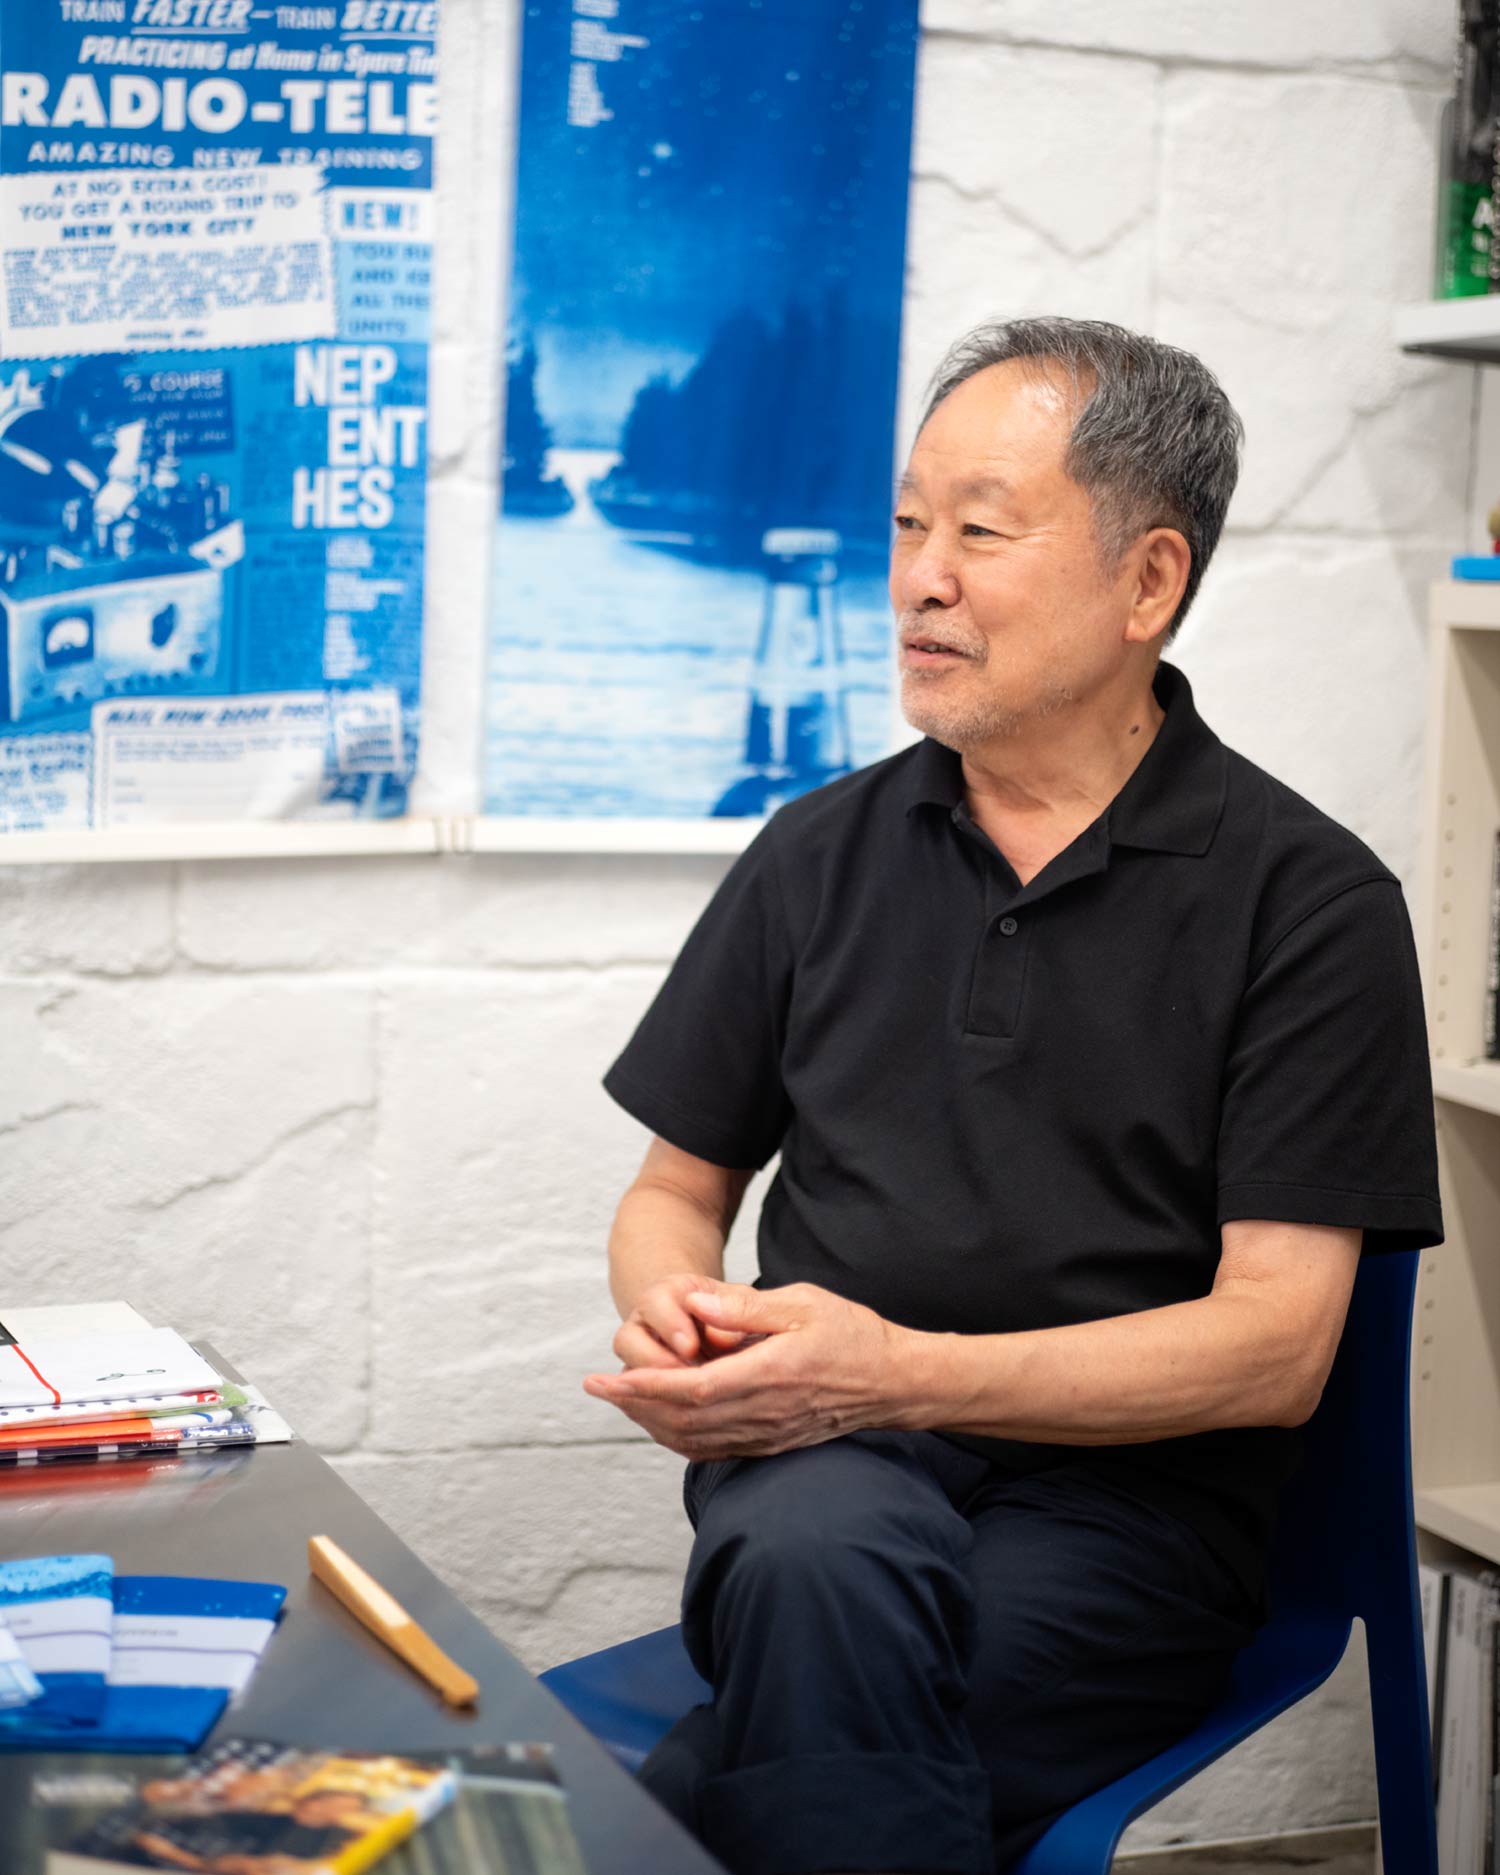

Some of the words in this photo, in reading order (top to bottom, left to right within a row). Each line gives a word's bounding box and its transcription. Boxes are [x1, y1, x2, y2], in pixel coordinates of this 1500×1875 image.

[60, 0, 125, 22] TRAIN
[78, 35, 227, 70] PRACTICING
[227, 43, 256, 70] at
[254, 41, 317, 72] Home
[317, 43, 344, 72] in
[1, 72, 437, 136] RADIO-TELE
[28, 141, 175, 168] AMAZING
[193, 149, 263, 169] NEW
[278, 149, 423, 171] TRAINING
[52, 182, 78, 198] AT
[87, 180, 121, 195] NO
[132, 178, 192, 194] EXTRA
[20, 205, 64, 220] YOU
[72, 203, 110, 218] GET
[61, 224, 113, 240] NEW
[129, 220, 193, 237] YORK
